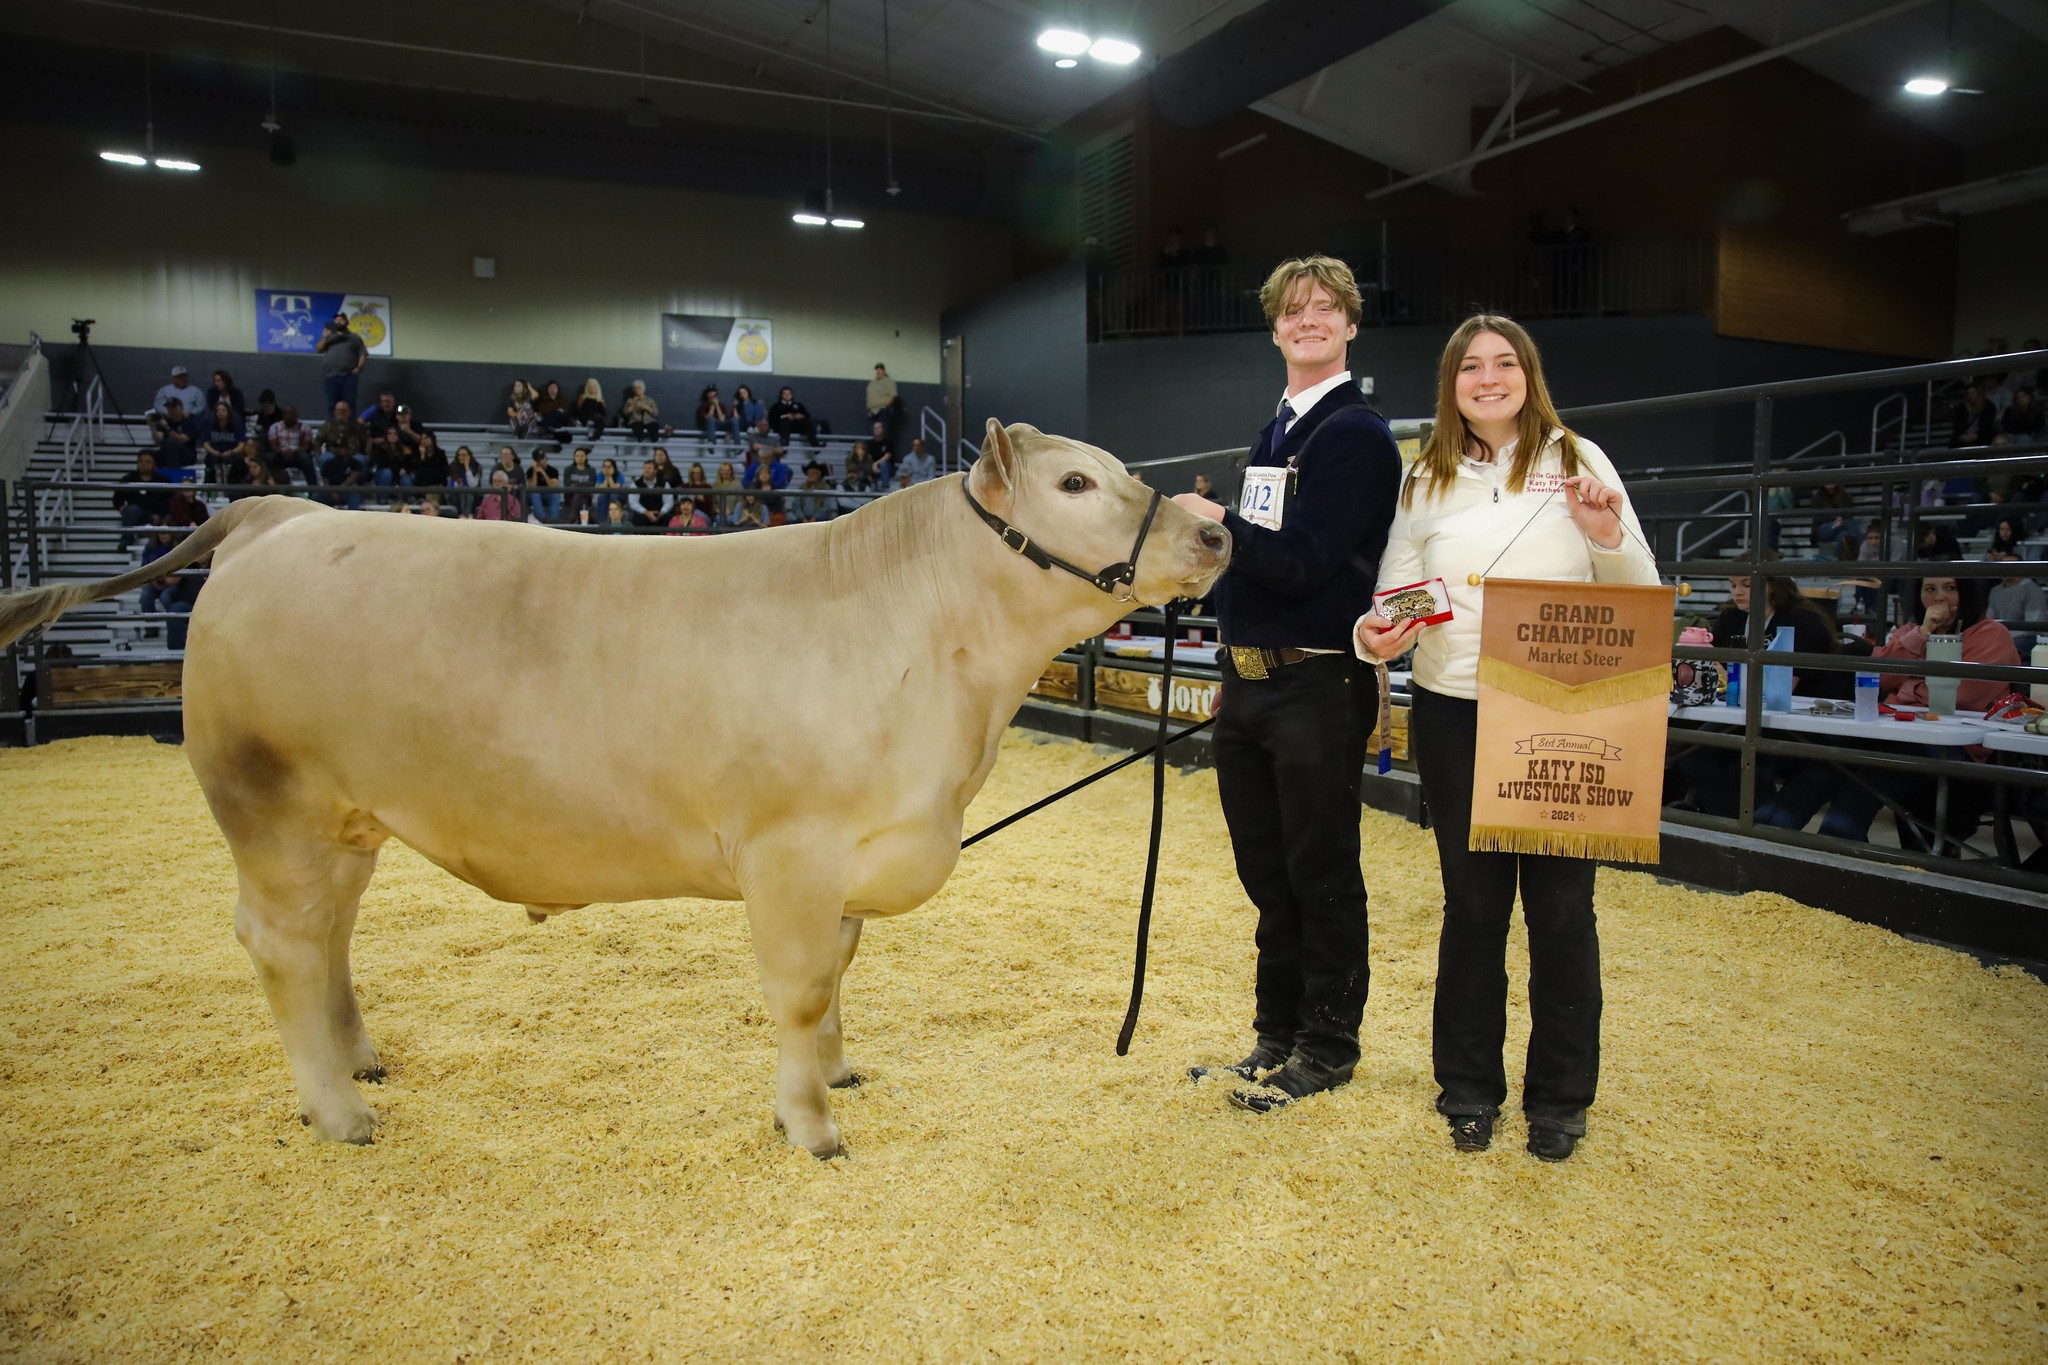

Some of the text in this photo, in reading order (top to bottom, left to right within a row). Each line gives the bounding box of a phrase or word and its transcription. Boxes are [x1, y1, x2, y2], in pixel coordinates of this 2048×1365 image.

[1529, 480, 1546, 488] Katy
[1539, 603, 1615, 625] GRAND
[1516, 623, 1635, 648] CHAMPION
[1528, 646, 1622, 667] Market Steer
[1556, 738, 1594, 750] Annual
[1527, 759, 1606, 785] KATY ISD
[1497, 781, 1634, 807] LIVESTOCK SHOW
[1551, 810, 1575, 821] 2024
